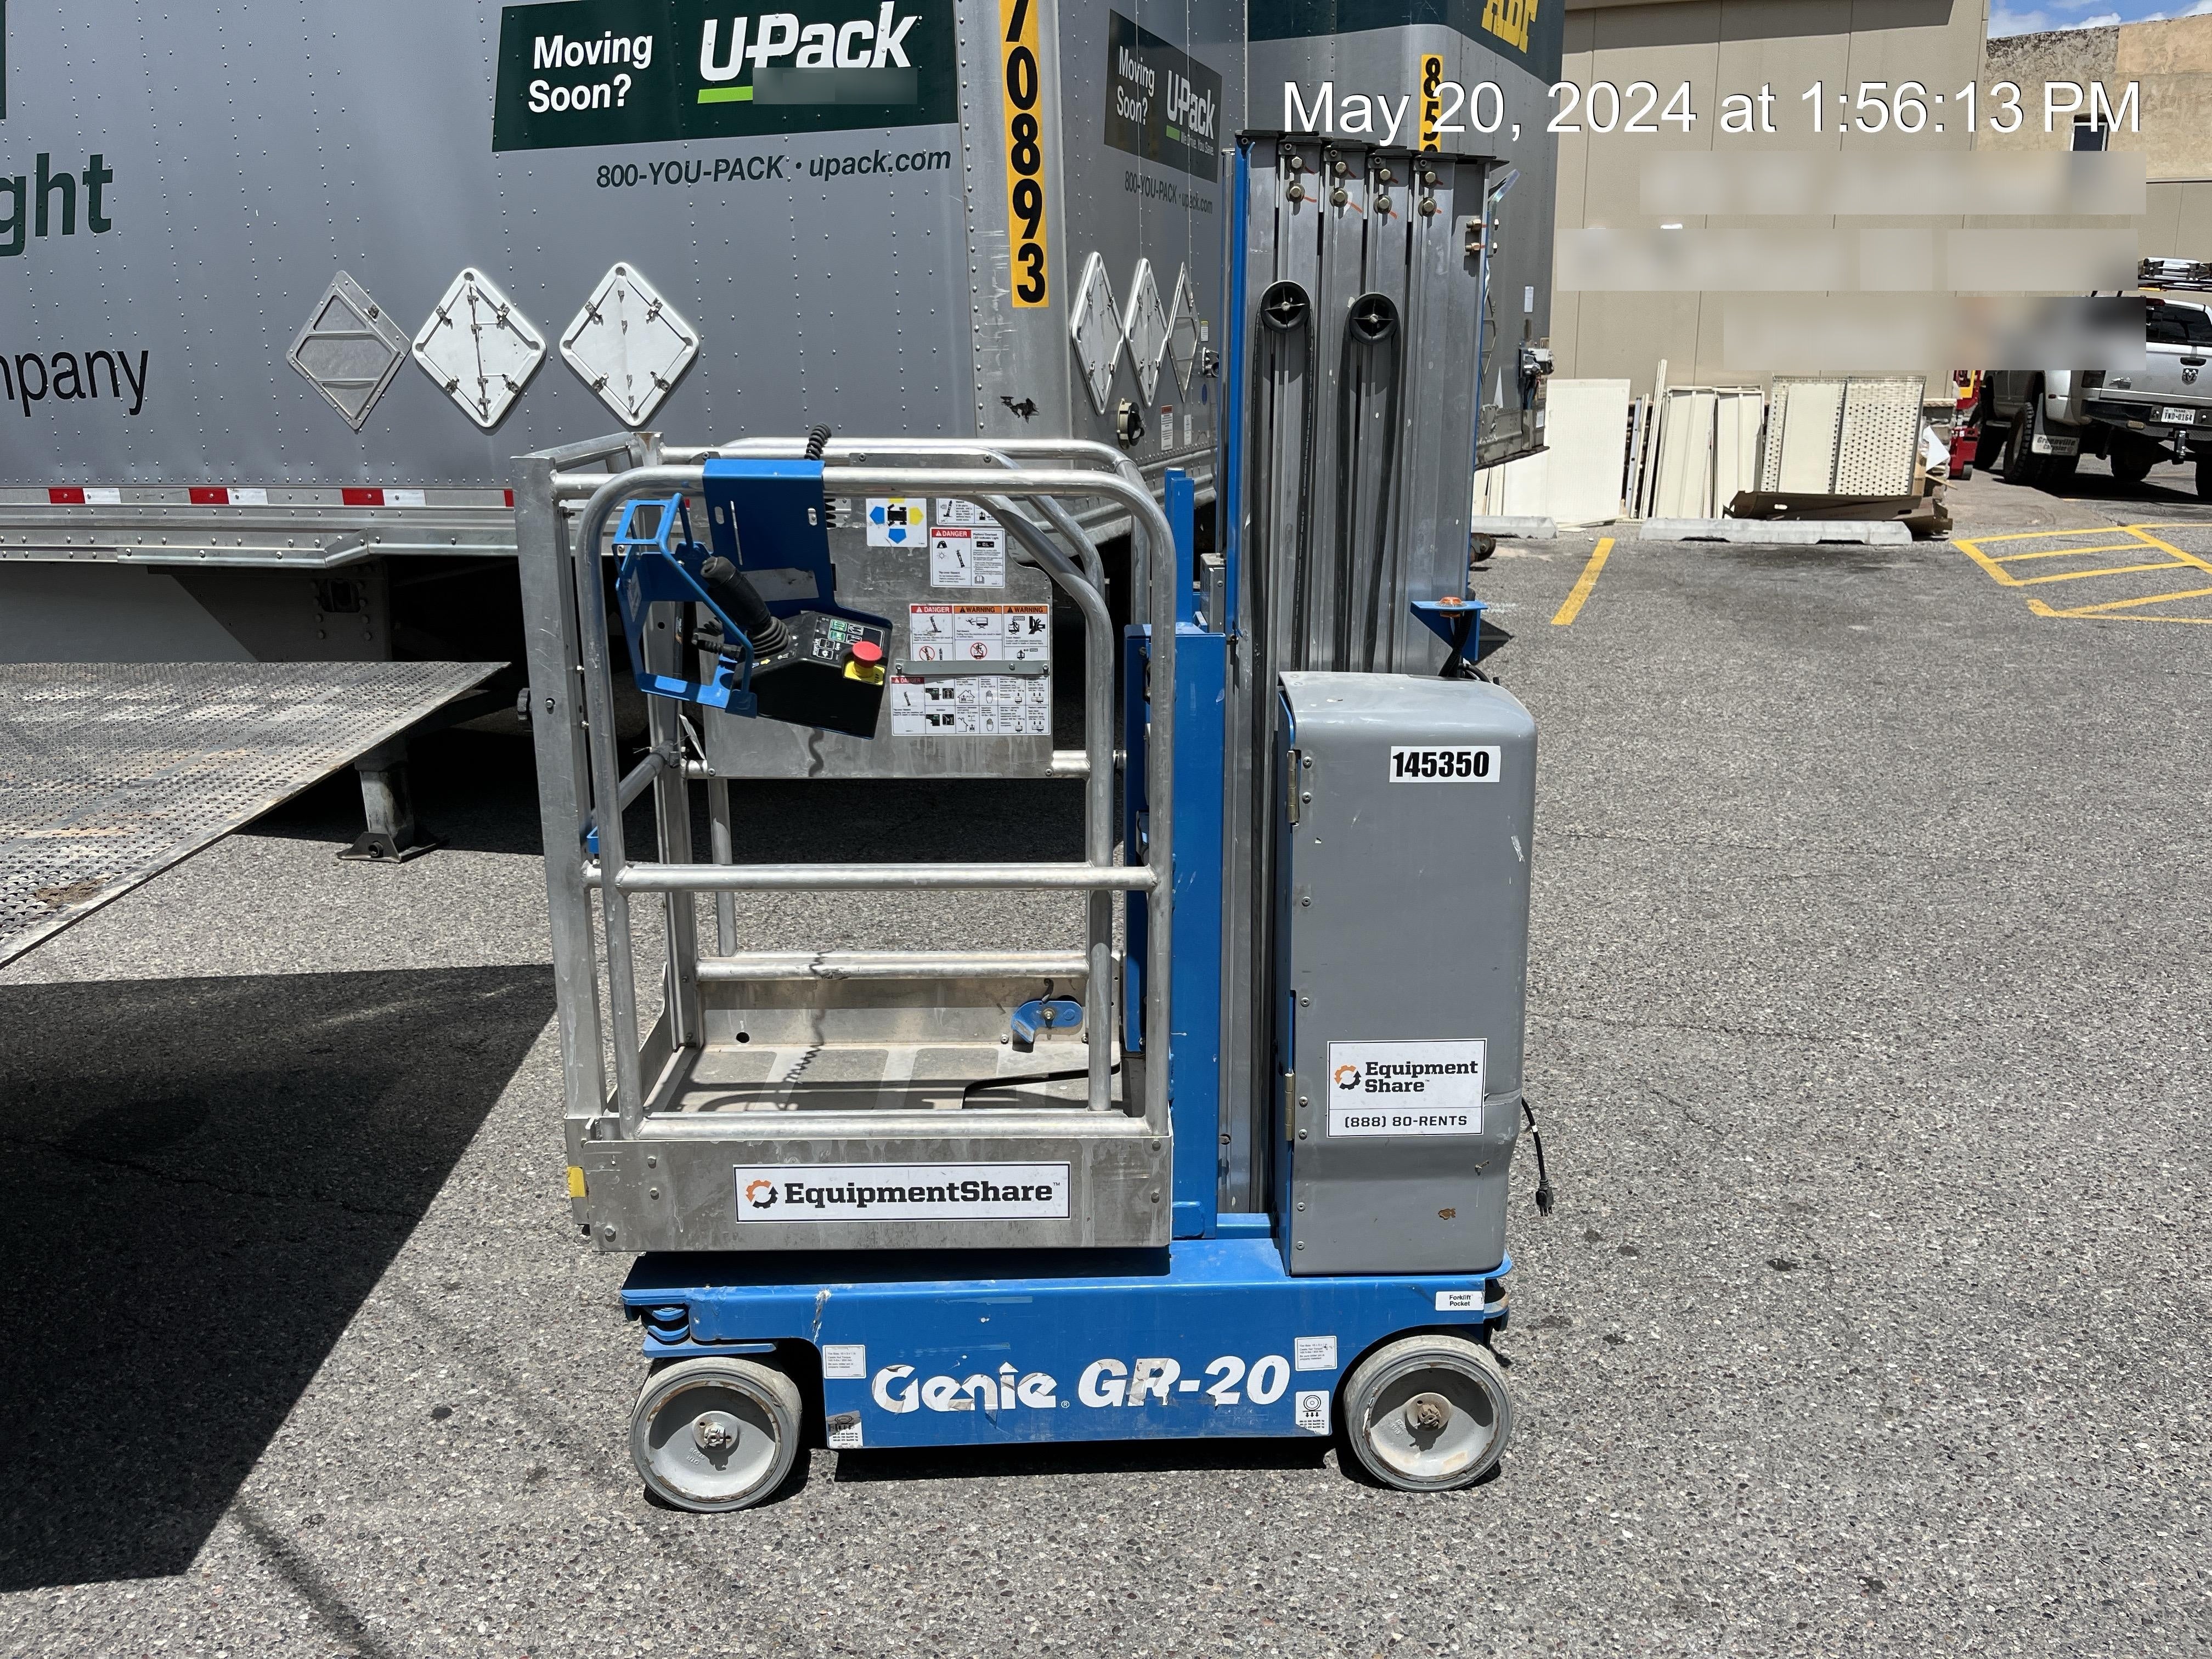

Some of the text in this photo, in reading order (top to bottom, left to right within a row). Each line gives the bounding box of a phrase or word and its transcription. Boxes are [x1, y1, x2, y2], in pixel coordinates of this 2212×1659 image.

[533, 31, 652, 70] Moving
[1119, 46, 1155, 97] Moving
[528, 74, 631, 113] Soon?
[1117, 86, 1148, 125] Soon?
[596, 149, 951, 189] 800-YOU-PACK upack.com
[1125, 171, 1213, 215] 800-YOU-PACK upack.com
[1392, 751, 1489, 777] 145350
[1365, 1061, 1478, 1078] Equipment
[1365, 1079, 1425, 1092] Share
[1345, 1115, 1468, 1128] (888) 80-RENTS
[785, 1181, 1053, 1208] EquipmentShare
[872, 1361, 1057, 1413] Genie
[1078, 1355, 1290, 1407] GR-20
